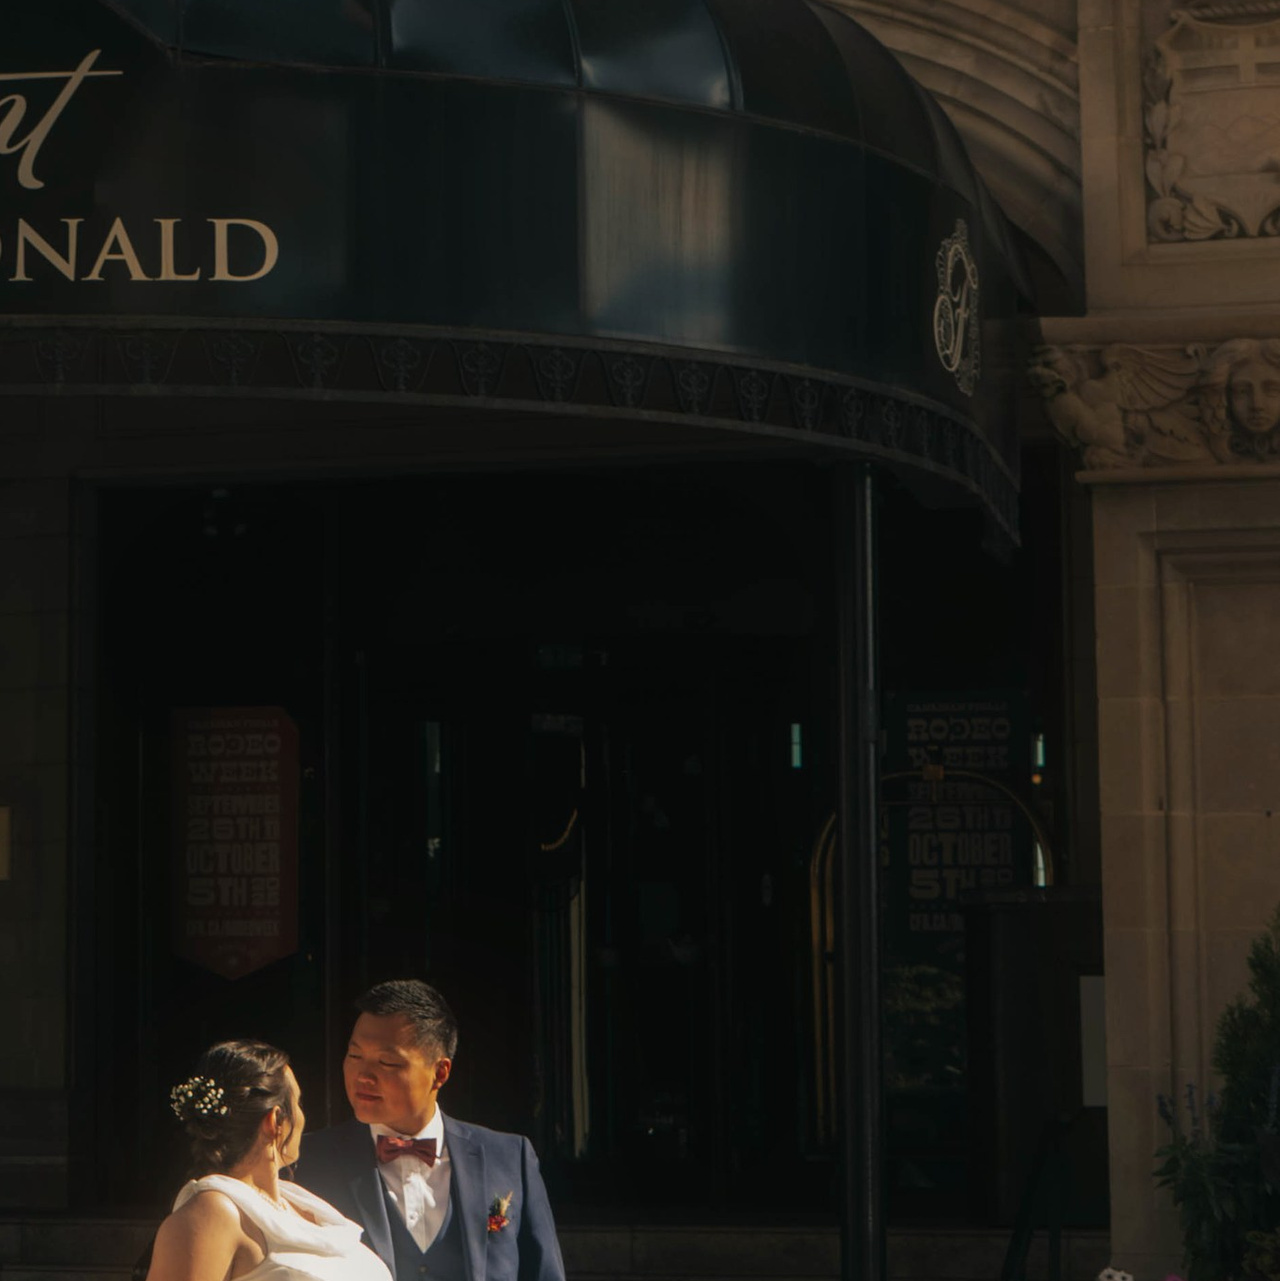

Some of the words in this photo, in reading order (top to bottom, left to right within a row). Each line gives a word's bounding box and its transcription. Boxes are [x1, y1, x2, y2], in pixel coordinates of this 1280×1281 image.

[906, 717, 1011, 742] RODEO
[187, 733, 282, 757] RODEO
[187, 760, 279, 783] WEEK
[186, 817, 261, 841] 26TH
[186, 841, 281, 874] OCTOBER
[908, 831, 1014, 866] OCTOBER
[187, 876, 248, 906] 5TH
